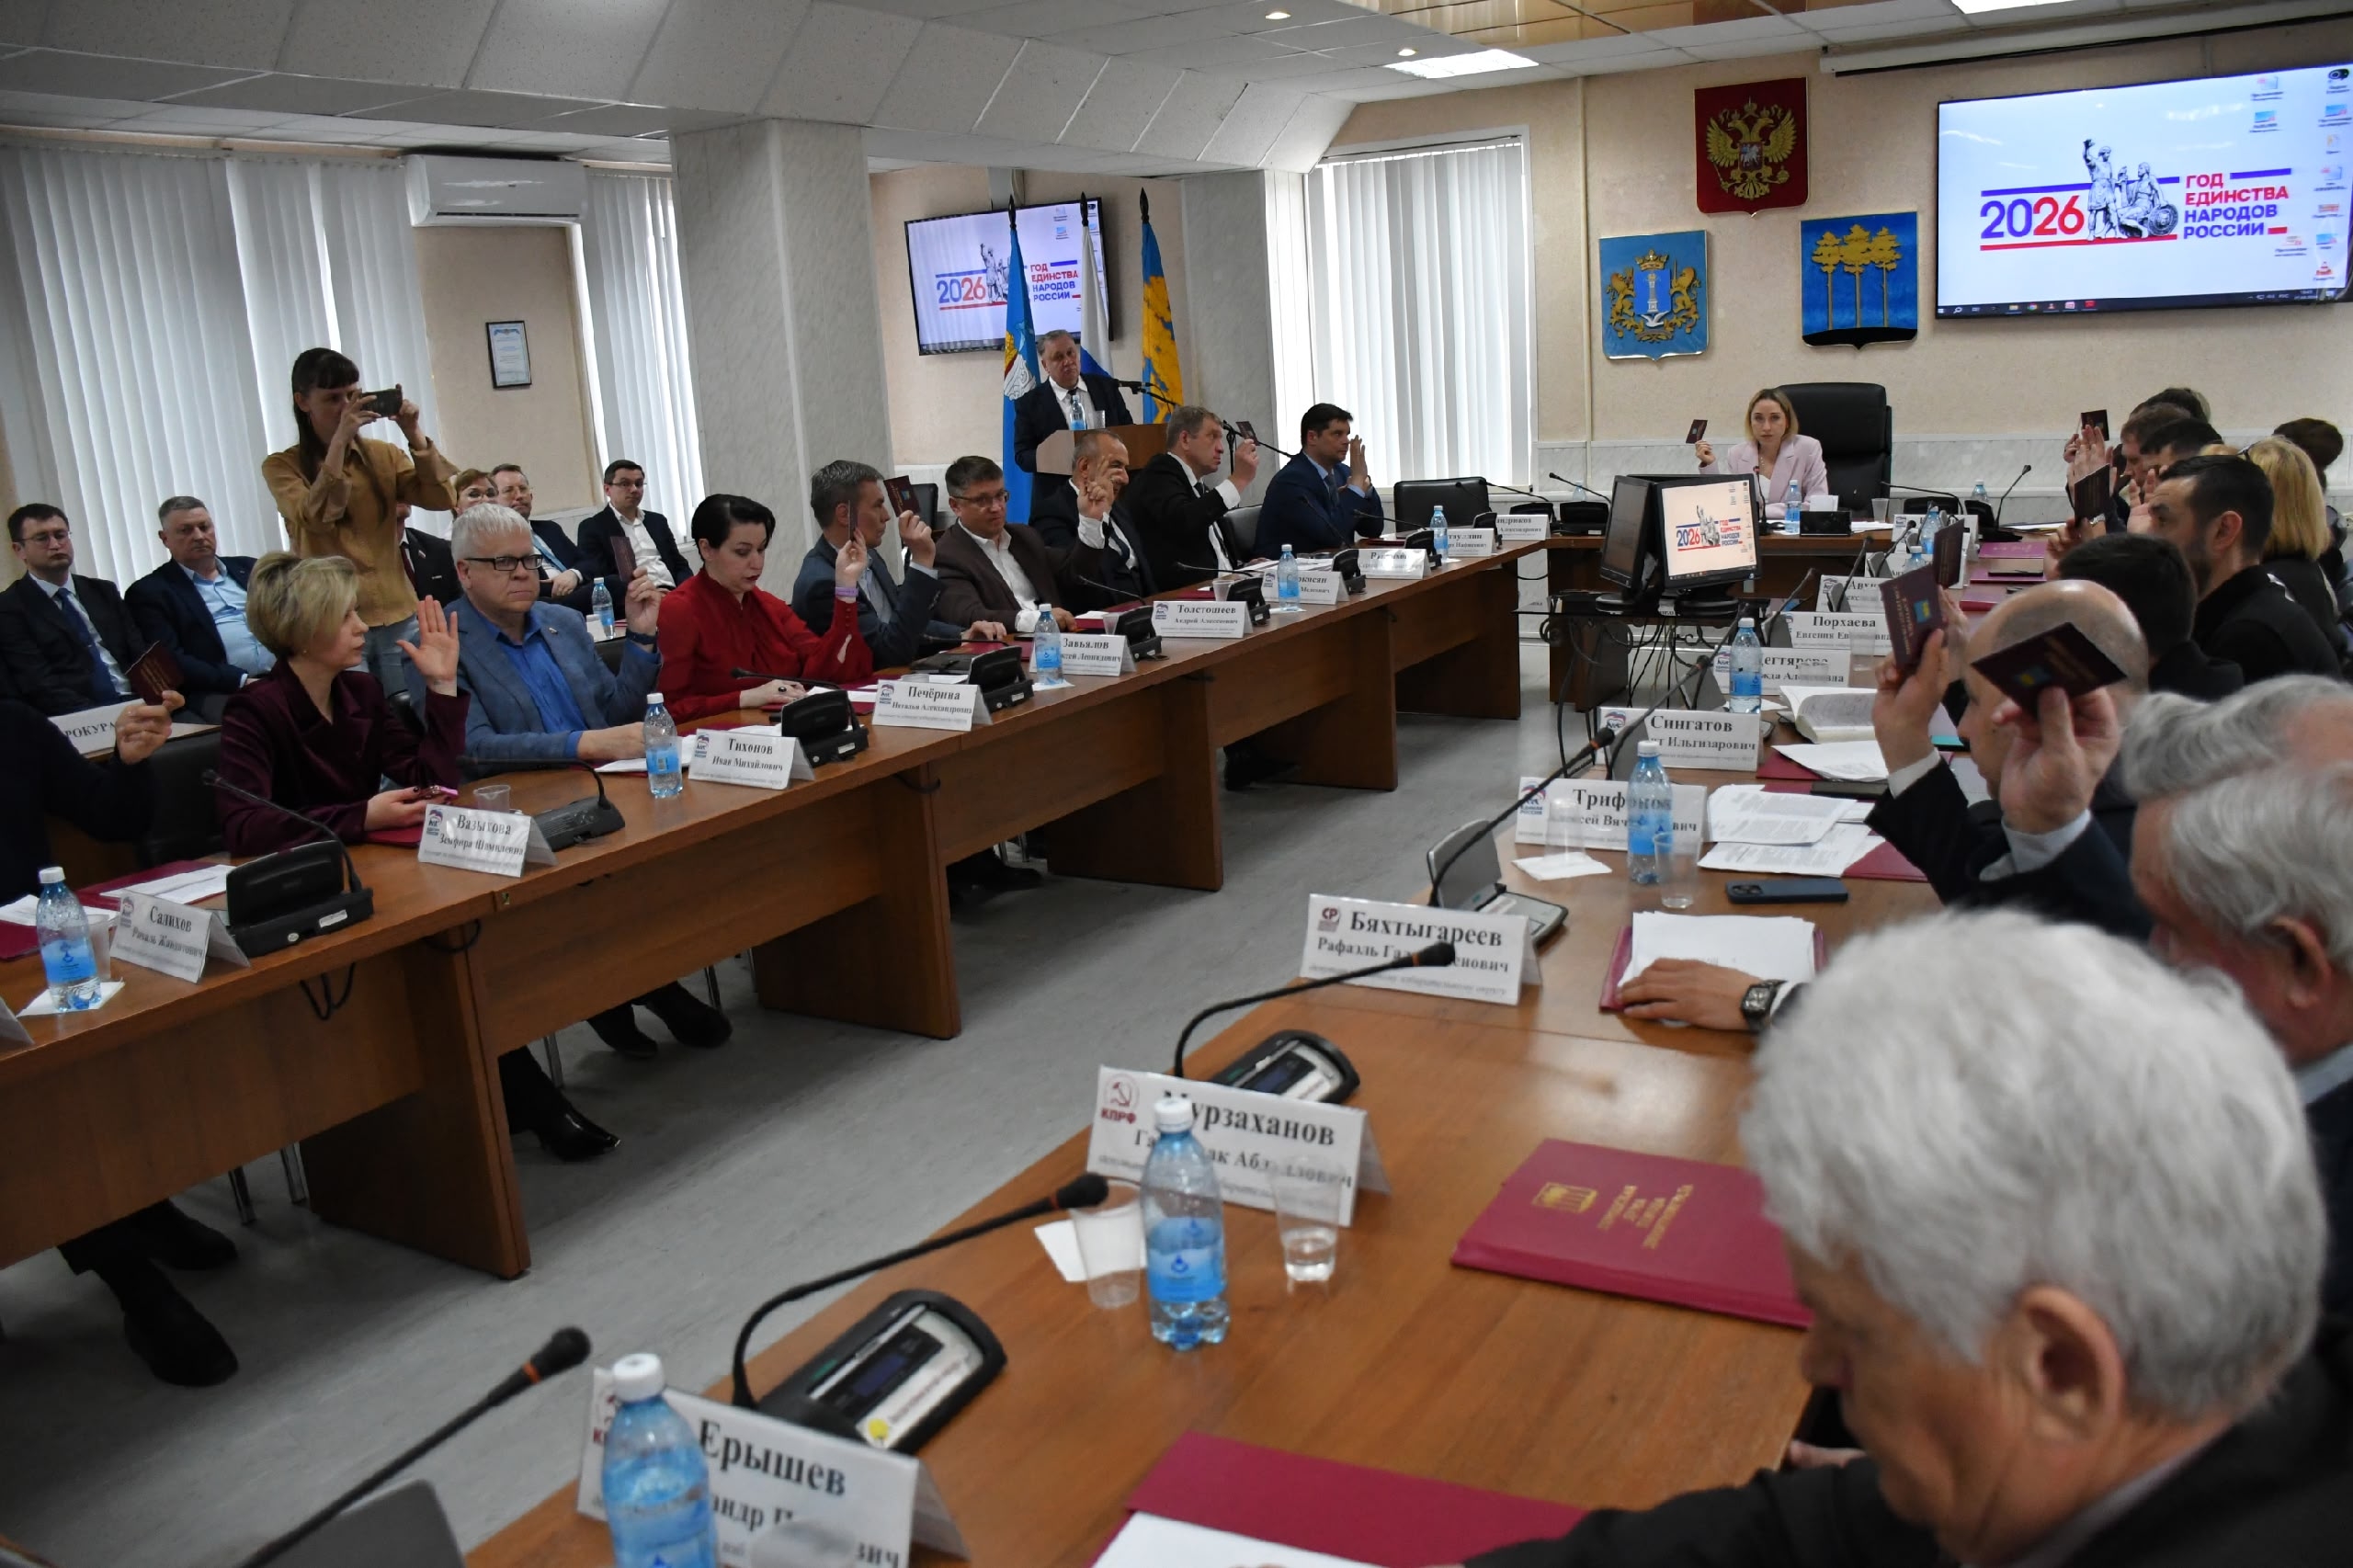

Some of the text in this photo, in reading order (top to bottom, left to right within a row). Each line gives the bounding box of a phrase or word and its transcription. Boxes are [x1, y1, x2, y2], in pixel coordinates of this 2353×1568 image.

[2186, 173, 2223, 189] ГОД
[2185, 186, 2289, 206] ЕДИНСТВА
[1981, 195, 2085, 239] 2026
[2184, 204, 2278, 223] НАРОДОВ
[2183, 222, 2265, 240] РОССИИ
[1030, 263, 1048, 273] ГОД
[1031, 269, 1079, 283] ЕДИНСТВА
[936, 277, 986, 303] 2026
[1032, 281, 1075, 293] НАРОДОВ
[1033, 291, 1071, 302] РОССИИ
[1677, 528, 1700, 547] 2026
[1176, 604, 1236, 614] Толстошеев
[1813, 616, 1877, 630] Порхаева
[1063, 637, 1109, 650] Завьялов
[1795, 631, 1835, 640] Евгения
[1761, 654, 1829, 670] егтярева
[908, 686, 961, 702] Печёрина
[892, 701, 972, 715] Наталья Александровна
[1650, 715, 1733, 733] Сингатов
[728, 738, 773, 755] Тихонов
[1667, 736, 1756, 752] Ильгизарович
[711, 756, 783, 771] Иван Михайлович
[439, 833, 473, 850] Земфира
[149, 905, 192, 933] Салихов
[1349, 911, 1503, 946] Бяхтыгареев
[1100, 1108, 1137, 1124] КПРФ
[1164, 1090, 1336, 1146] урзаханов
[699, 1418, 847, 1497] Ерышев
